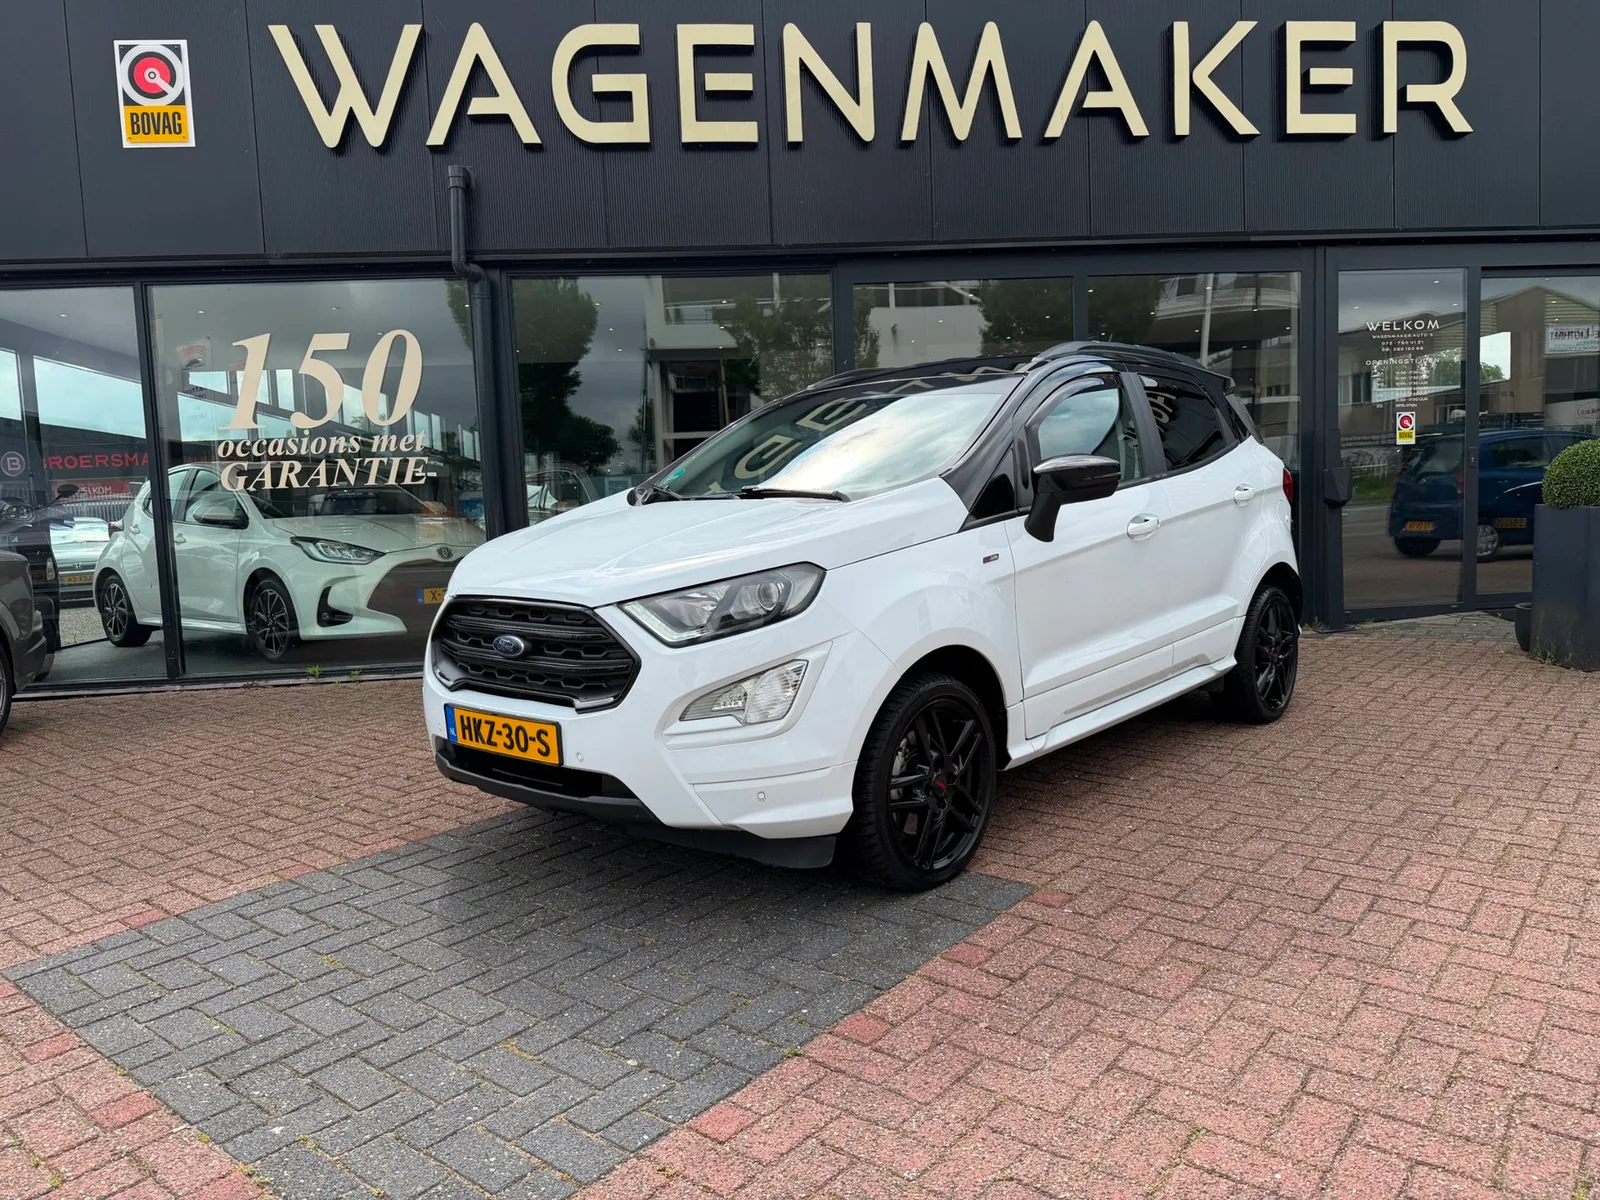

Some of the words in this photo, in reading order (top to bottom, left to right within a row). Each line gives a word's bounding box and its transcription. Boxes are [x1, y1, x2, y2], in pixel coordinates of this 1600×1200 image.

[267, 20, 1474, 149] WAGENMAKER
[130, 111, 183, 136] BOVAG
[1366, 320, 1440, 331] WELKOM
[1365, 357, 1440, 366] OPENINGSTIJDEN
[218, 329, 423, 430] 150
[217, 430, 361, 458] occasions
[370, 430, 426, 453] met
[220, 456, 429, 492] GARANTIE
[459, 714, 551, 757] HKZ-30-S
